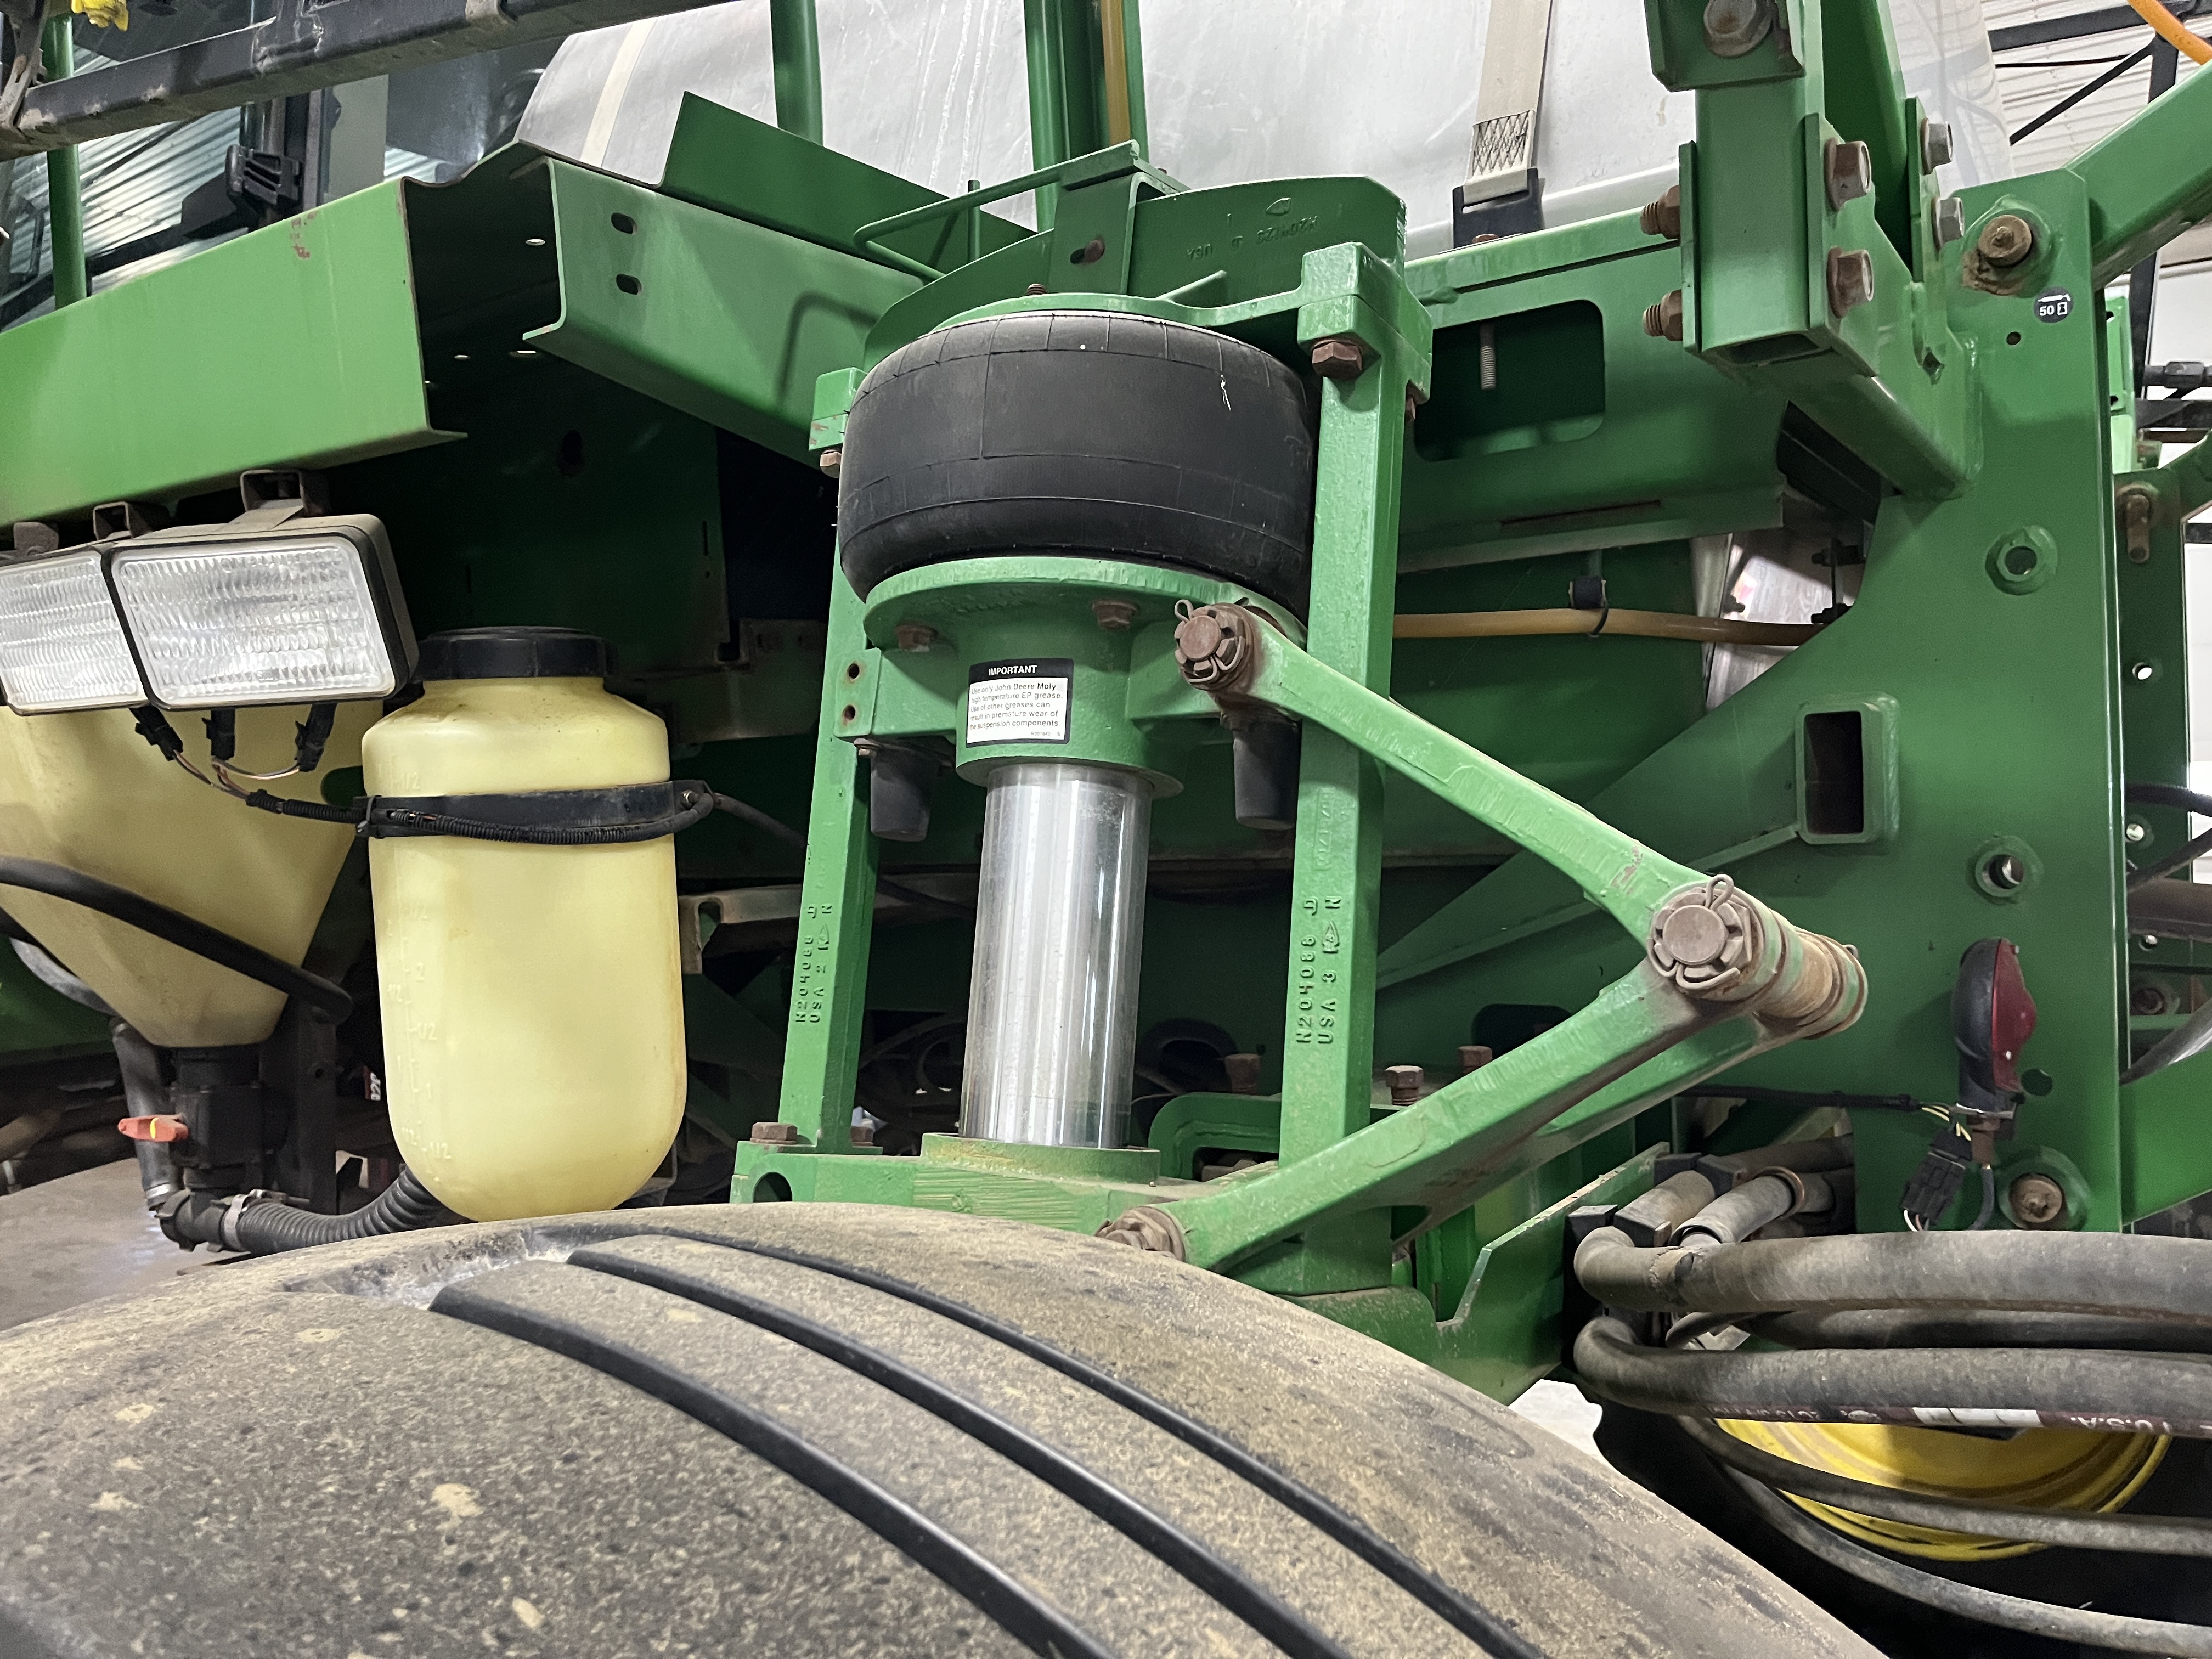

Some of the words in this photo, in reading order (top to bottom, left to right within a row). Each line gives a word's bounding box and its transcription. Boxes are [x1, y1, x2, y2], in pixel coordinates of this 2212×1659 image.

[2039, 305, 2055, 317] 50
[988, 665, 1037, 676] IMPORTANT
[981, 685, 994, 693] only
[995, 683, 1011, 691] John
[1037, 682, 1057, 691] Moly
[982, 693, 1019, 702] temperature
[1034, 692, 1063, 701] grease.
[1005, 702, 1034, 710] greases
[991, 711, 1026, 720] premature
[977, 720, 1011, 730] suspension
[815, 964, 826, 974] 2
[1321, 970, 1337, 983] 3
[809, 988, 824, 1023] USA
[1317, 998, 1338, 1045] USA
